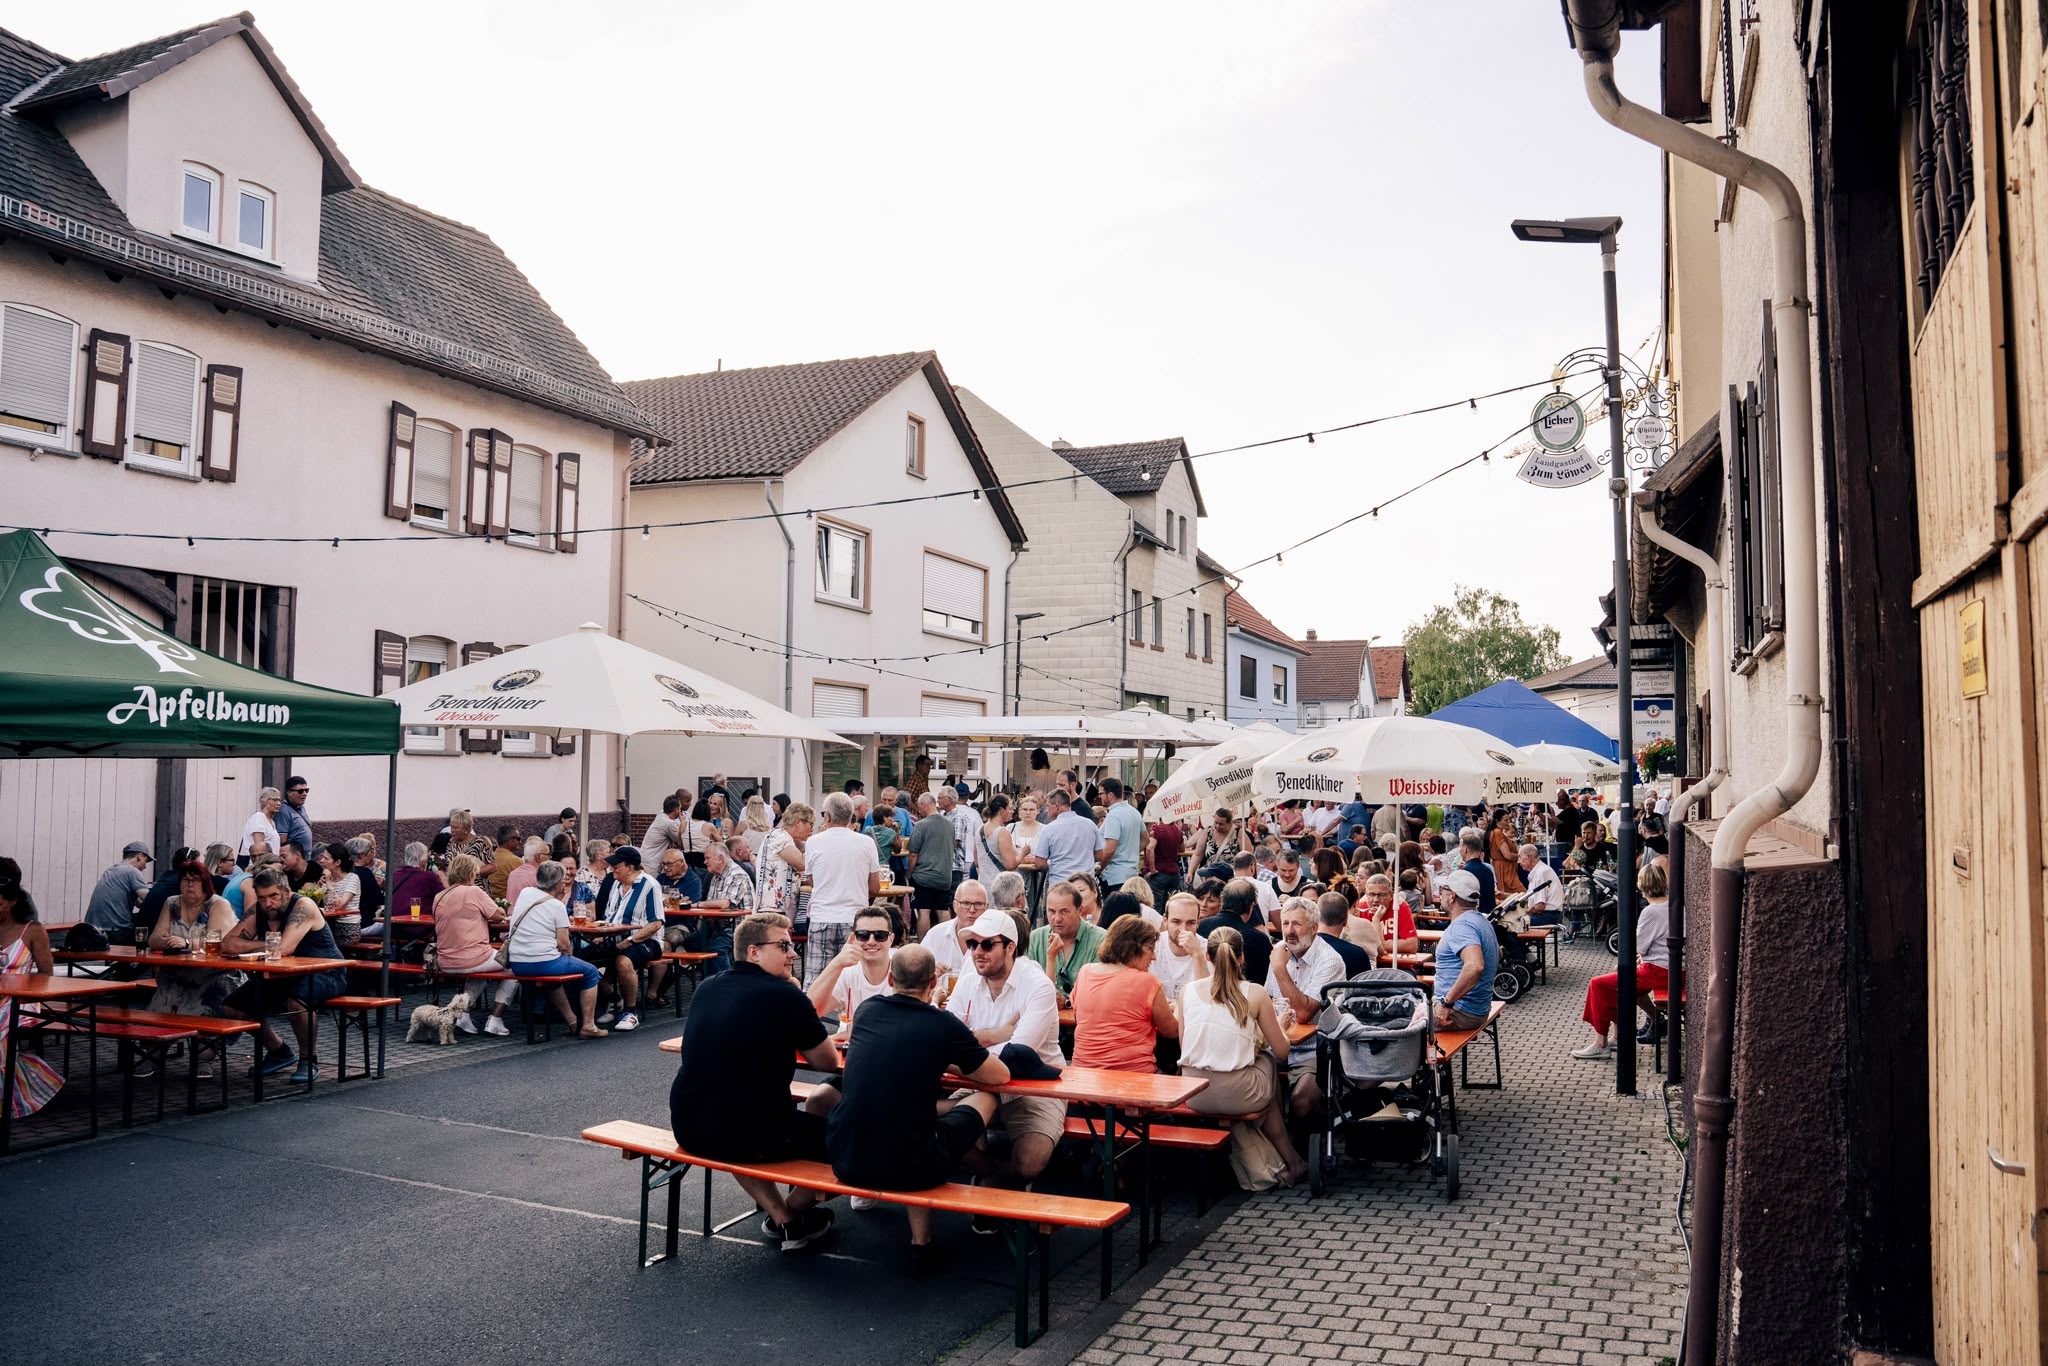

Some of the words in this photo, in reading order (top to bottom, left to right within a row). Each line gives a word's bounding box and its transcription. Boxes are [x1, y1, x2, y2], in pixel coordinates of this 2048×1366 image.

[1541, 415, 1575, 429] Licher
[1535, 454, 1584, 468] Landgasthof
[1527, 464, 1553, 479] Zum
[1556, 463, 1593, 480] Löwen
[107, 685, 290, 728] Apfelbaum
[424, 694, 546, 712] Benediktiner
[435, 711, 501, 721] Weissbier
[1205, 767, 1254, 792] Benediktin
[1276, 772, 1344, 794] Benediktiner
[1389, 778, 1455, 797] Weissbier
[1495, 776, 1544, 800] Benediktiner
